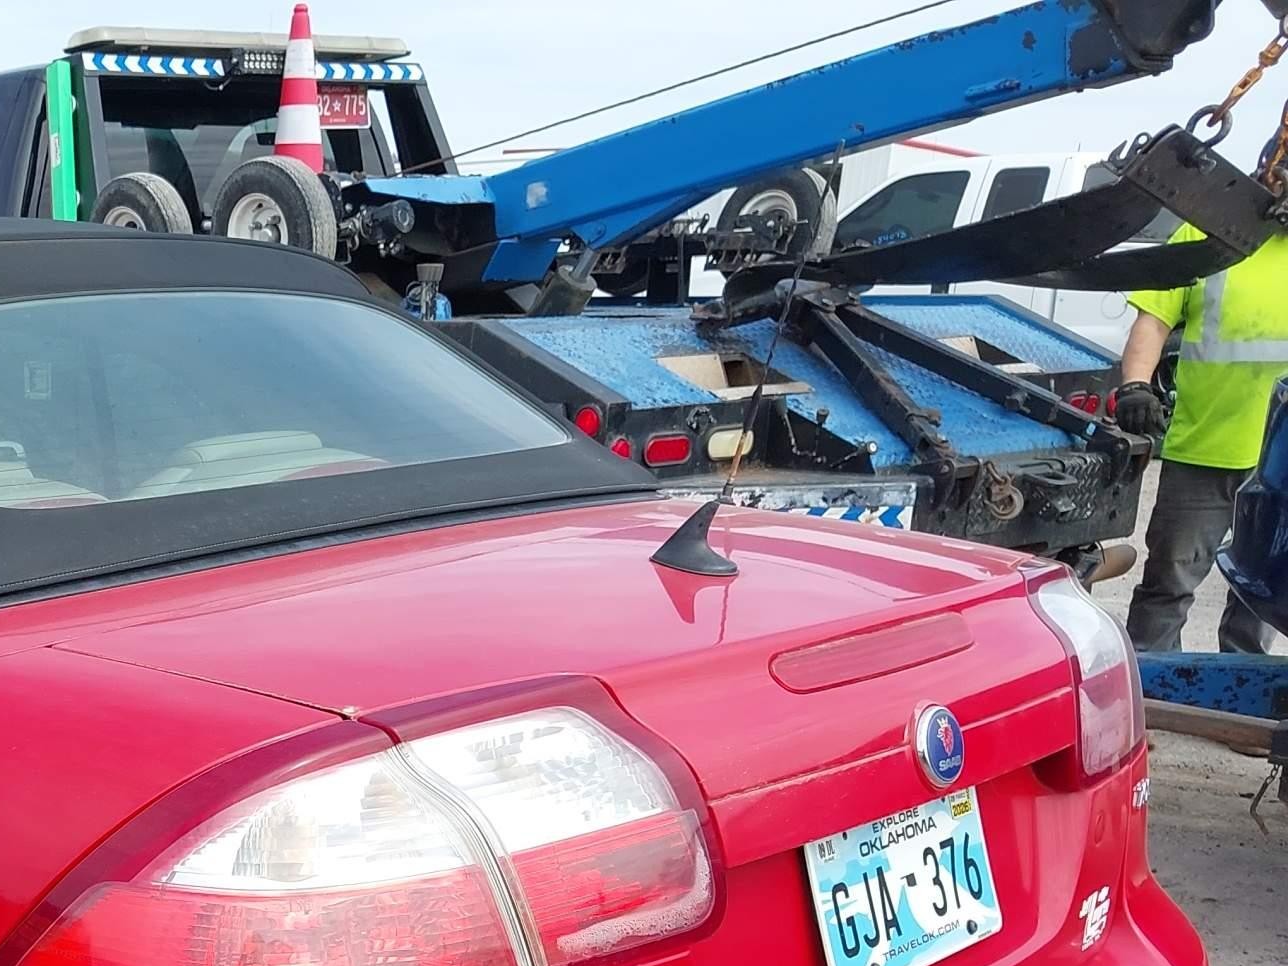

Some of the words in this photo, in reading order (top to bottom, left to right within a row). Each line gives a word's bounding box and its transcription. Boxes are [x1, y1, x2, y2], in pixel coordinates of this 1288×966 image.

[343, 94, 366, 116] 775
[939, 754, 962, 772] SAAB
[859, 816, 937, 858] OKLAHOMA
[872, 807, 920, 834] EXPLORE
[831, 866, 903, 959] GJA
[923, 832, 983, 917] 376
[882, 919, 961, 961] TRAVELOK.COM
